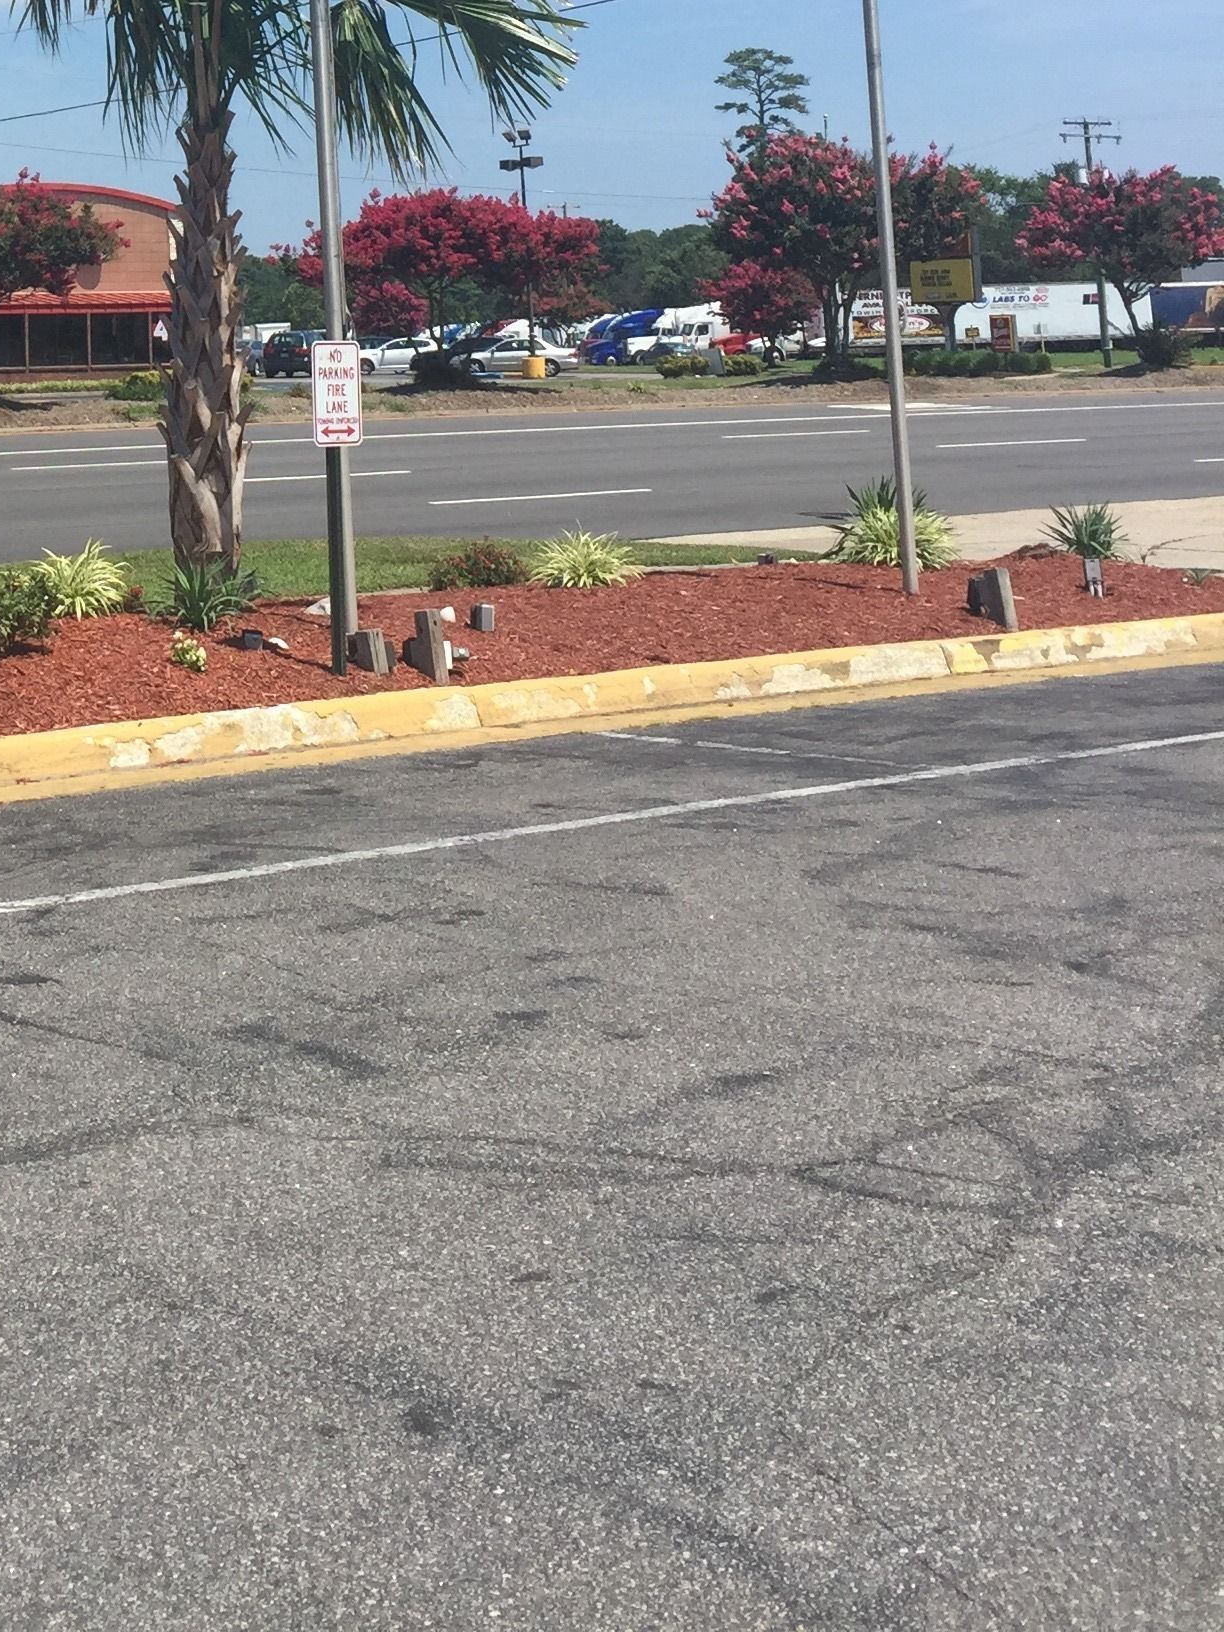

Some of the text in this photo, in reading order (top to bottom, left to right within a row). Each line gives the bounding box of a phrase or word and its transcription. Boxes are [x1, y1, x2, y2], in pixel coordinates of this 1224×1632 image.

[993, 295, 1016, 303] LABS
[1018, 294, 1030, 303] TO
[329, 350, 342, 363] NO
[318, 367, 355, 380] PARKING
[327, 383, 346, 396] FIRE
[326, 400, 348, 413] LANE
